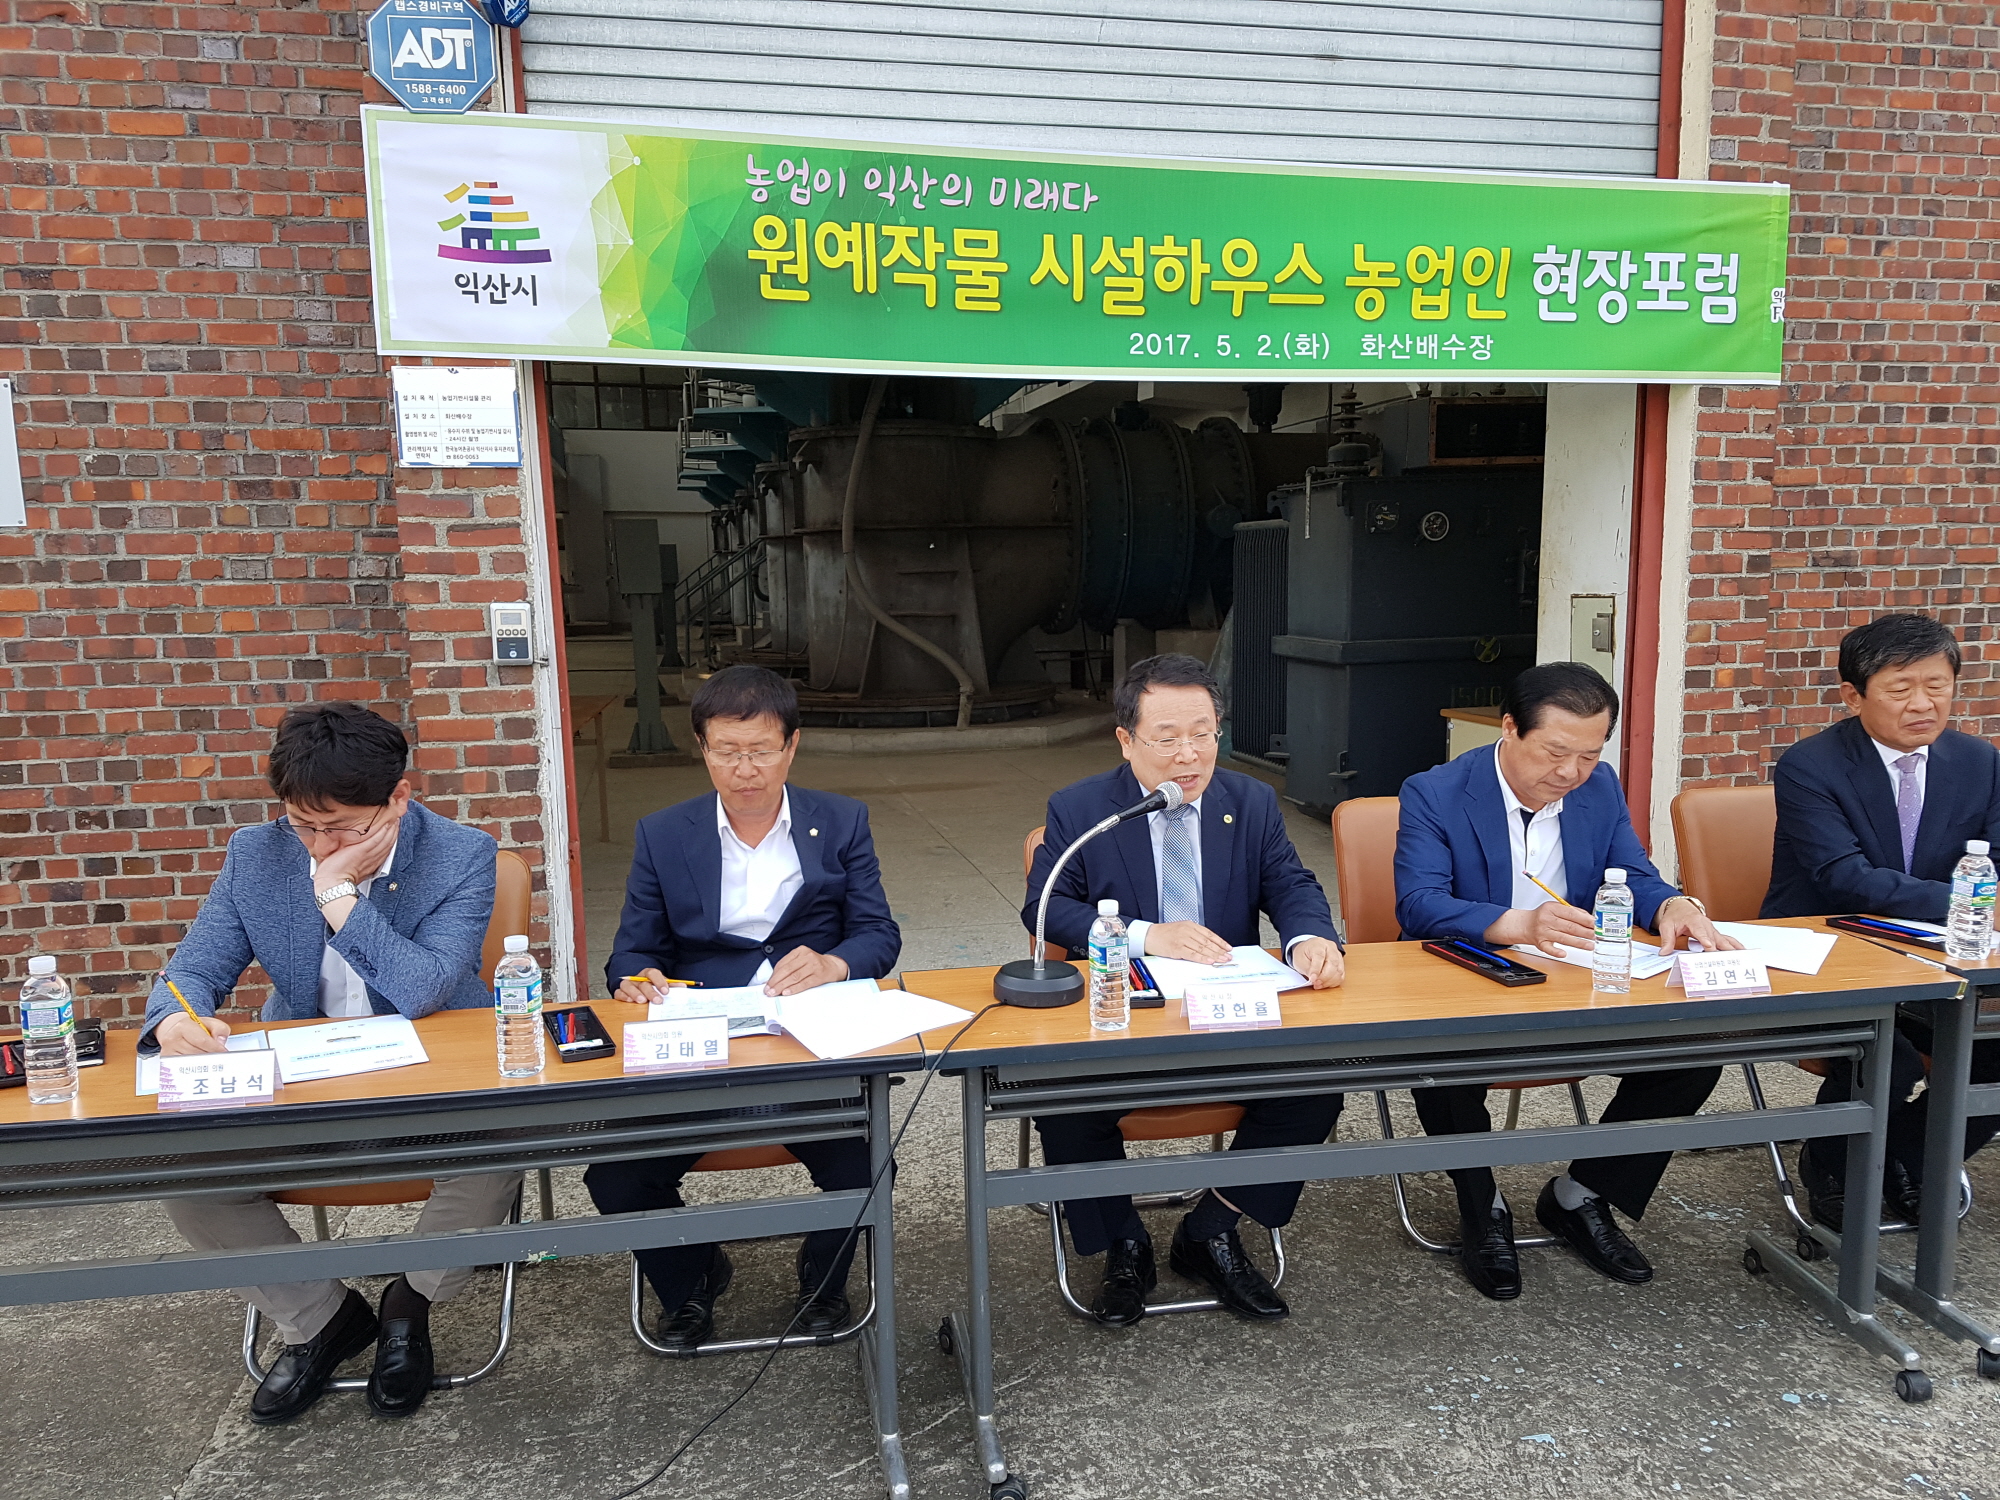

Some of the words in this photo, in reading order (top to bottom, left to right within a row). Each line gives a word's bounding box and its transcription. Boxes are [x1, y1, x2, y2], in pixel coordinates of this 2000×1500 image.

[395, 0, 464, 13] 캡스경비구역
[392, 28, 473, 70] ADT
[405, 84, 466, 95] 1588-6400
[745, 153, 847, 206] 농업이
[864, 165, 974, 210] 익산의
[990, 176, 1099, 212] 미래다
[747, 214, 1009, 312] 원예작물
[1030, 234, 1325, 317] 시설하우스
[1345, 243, 1511, 320] 농업인
[1532, 244, 1739, 324] 현장포럼
[454, 272, 538, 306] 익산시
[1773, 306, 1785, 320] F
[1129, 332, 1200, 358] 2017.
[1216, 333, 1240, 358] 5.
[1257, 332, 1331, 361] 2.(화)
[1360, 333, 1494, 361] 화산배수장
[179, 1065, 209, 1075] 익산시의회
[212, 1064, 224, 1072] 의원
